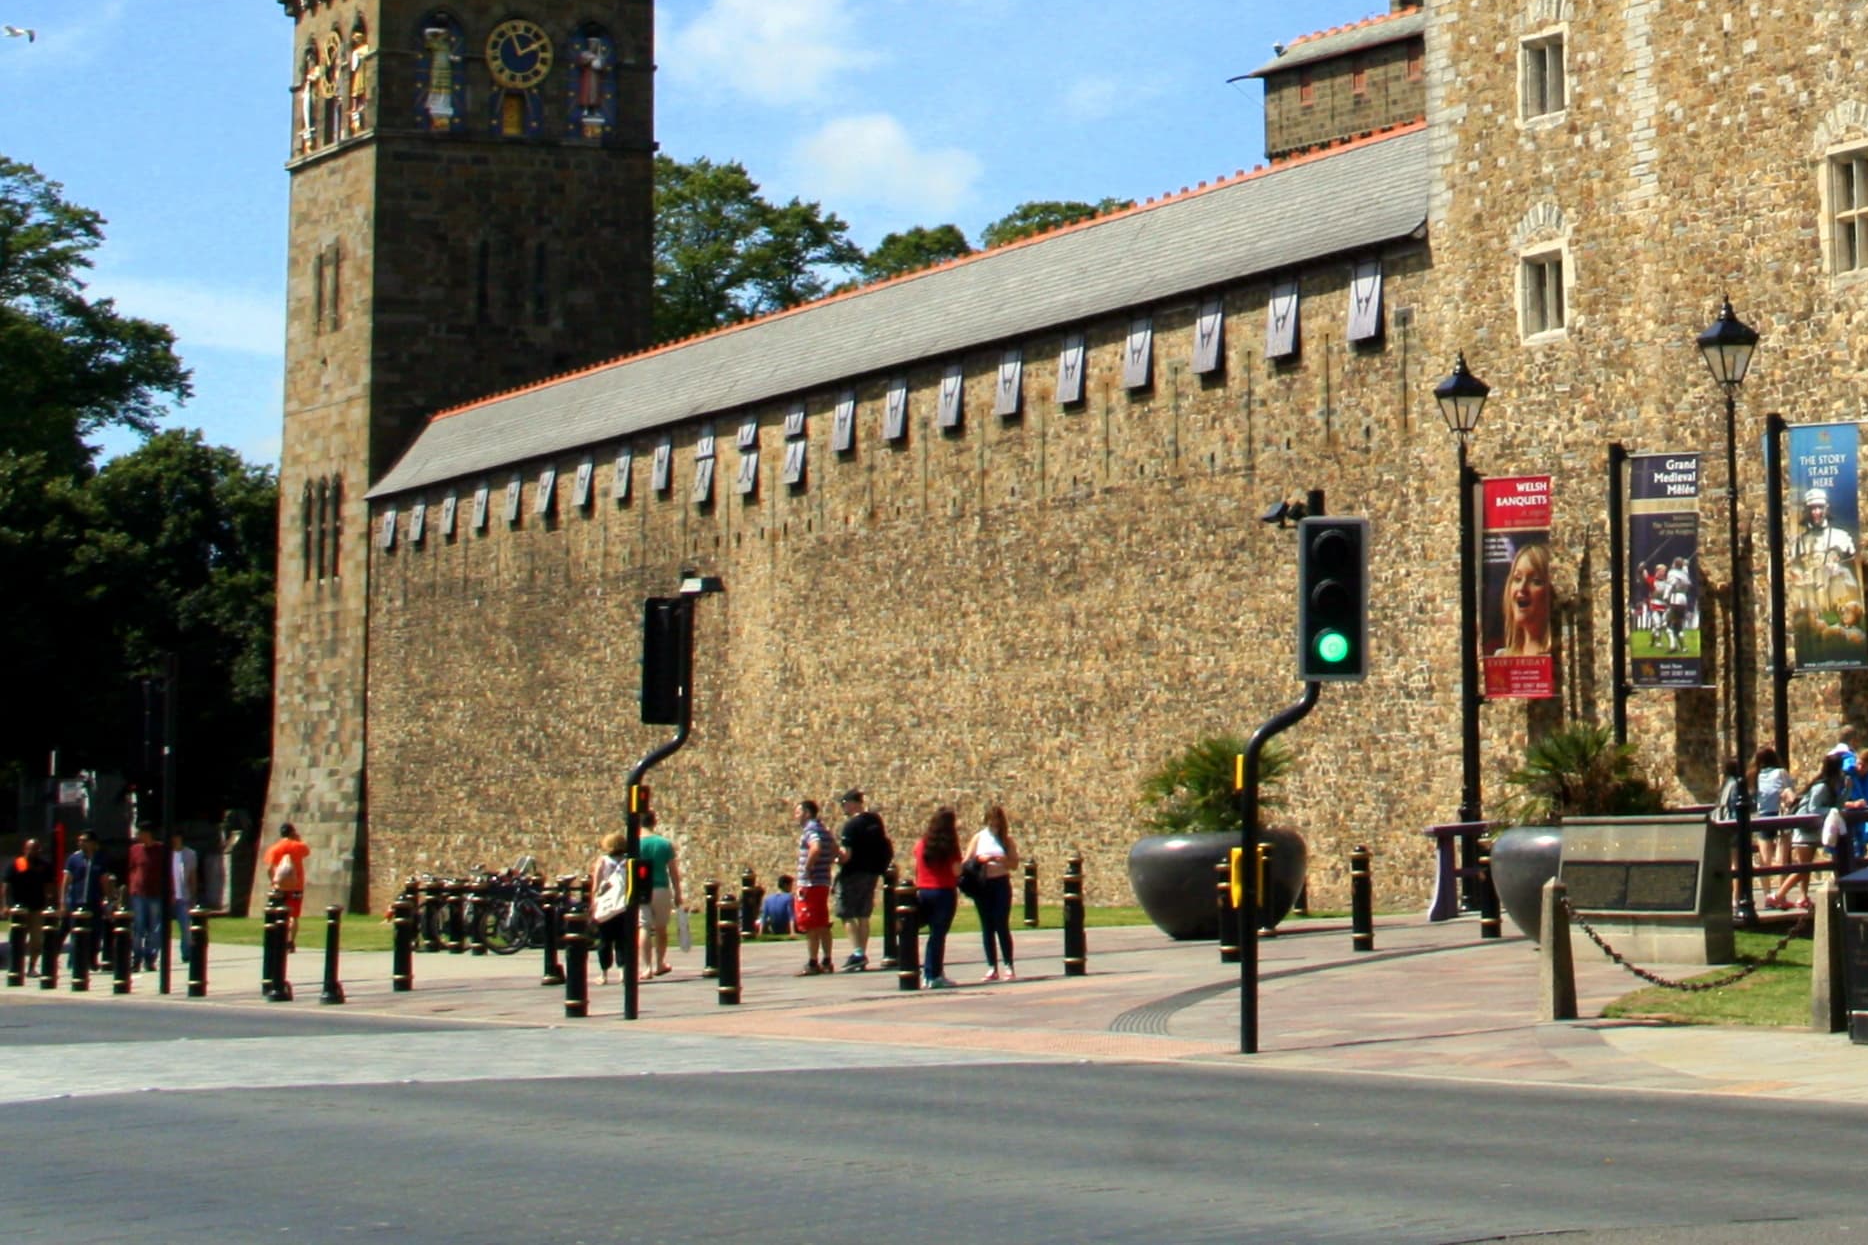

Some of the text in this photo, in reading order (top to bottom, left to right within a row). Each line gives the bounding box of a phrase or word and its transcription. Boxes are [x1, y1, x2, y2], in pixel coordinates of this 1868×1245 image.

[1665, 458, 1697, 471] Grand
[1800, 454, 1846, 466] THE STORY
[1808, 465, 1839, 476] STARTS
[1653, 471, 1697, 484] Medieval
[1812, 476, 1835, 487] HERE
[1516, 481, 1548, 492] WELSH
[1495, 495, 1548, 507] BANQUETS
